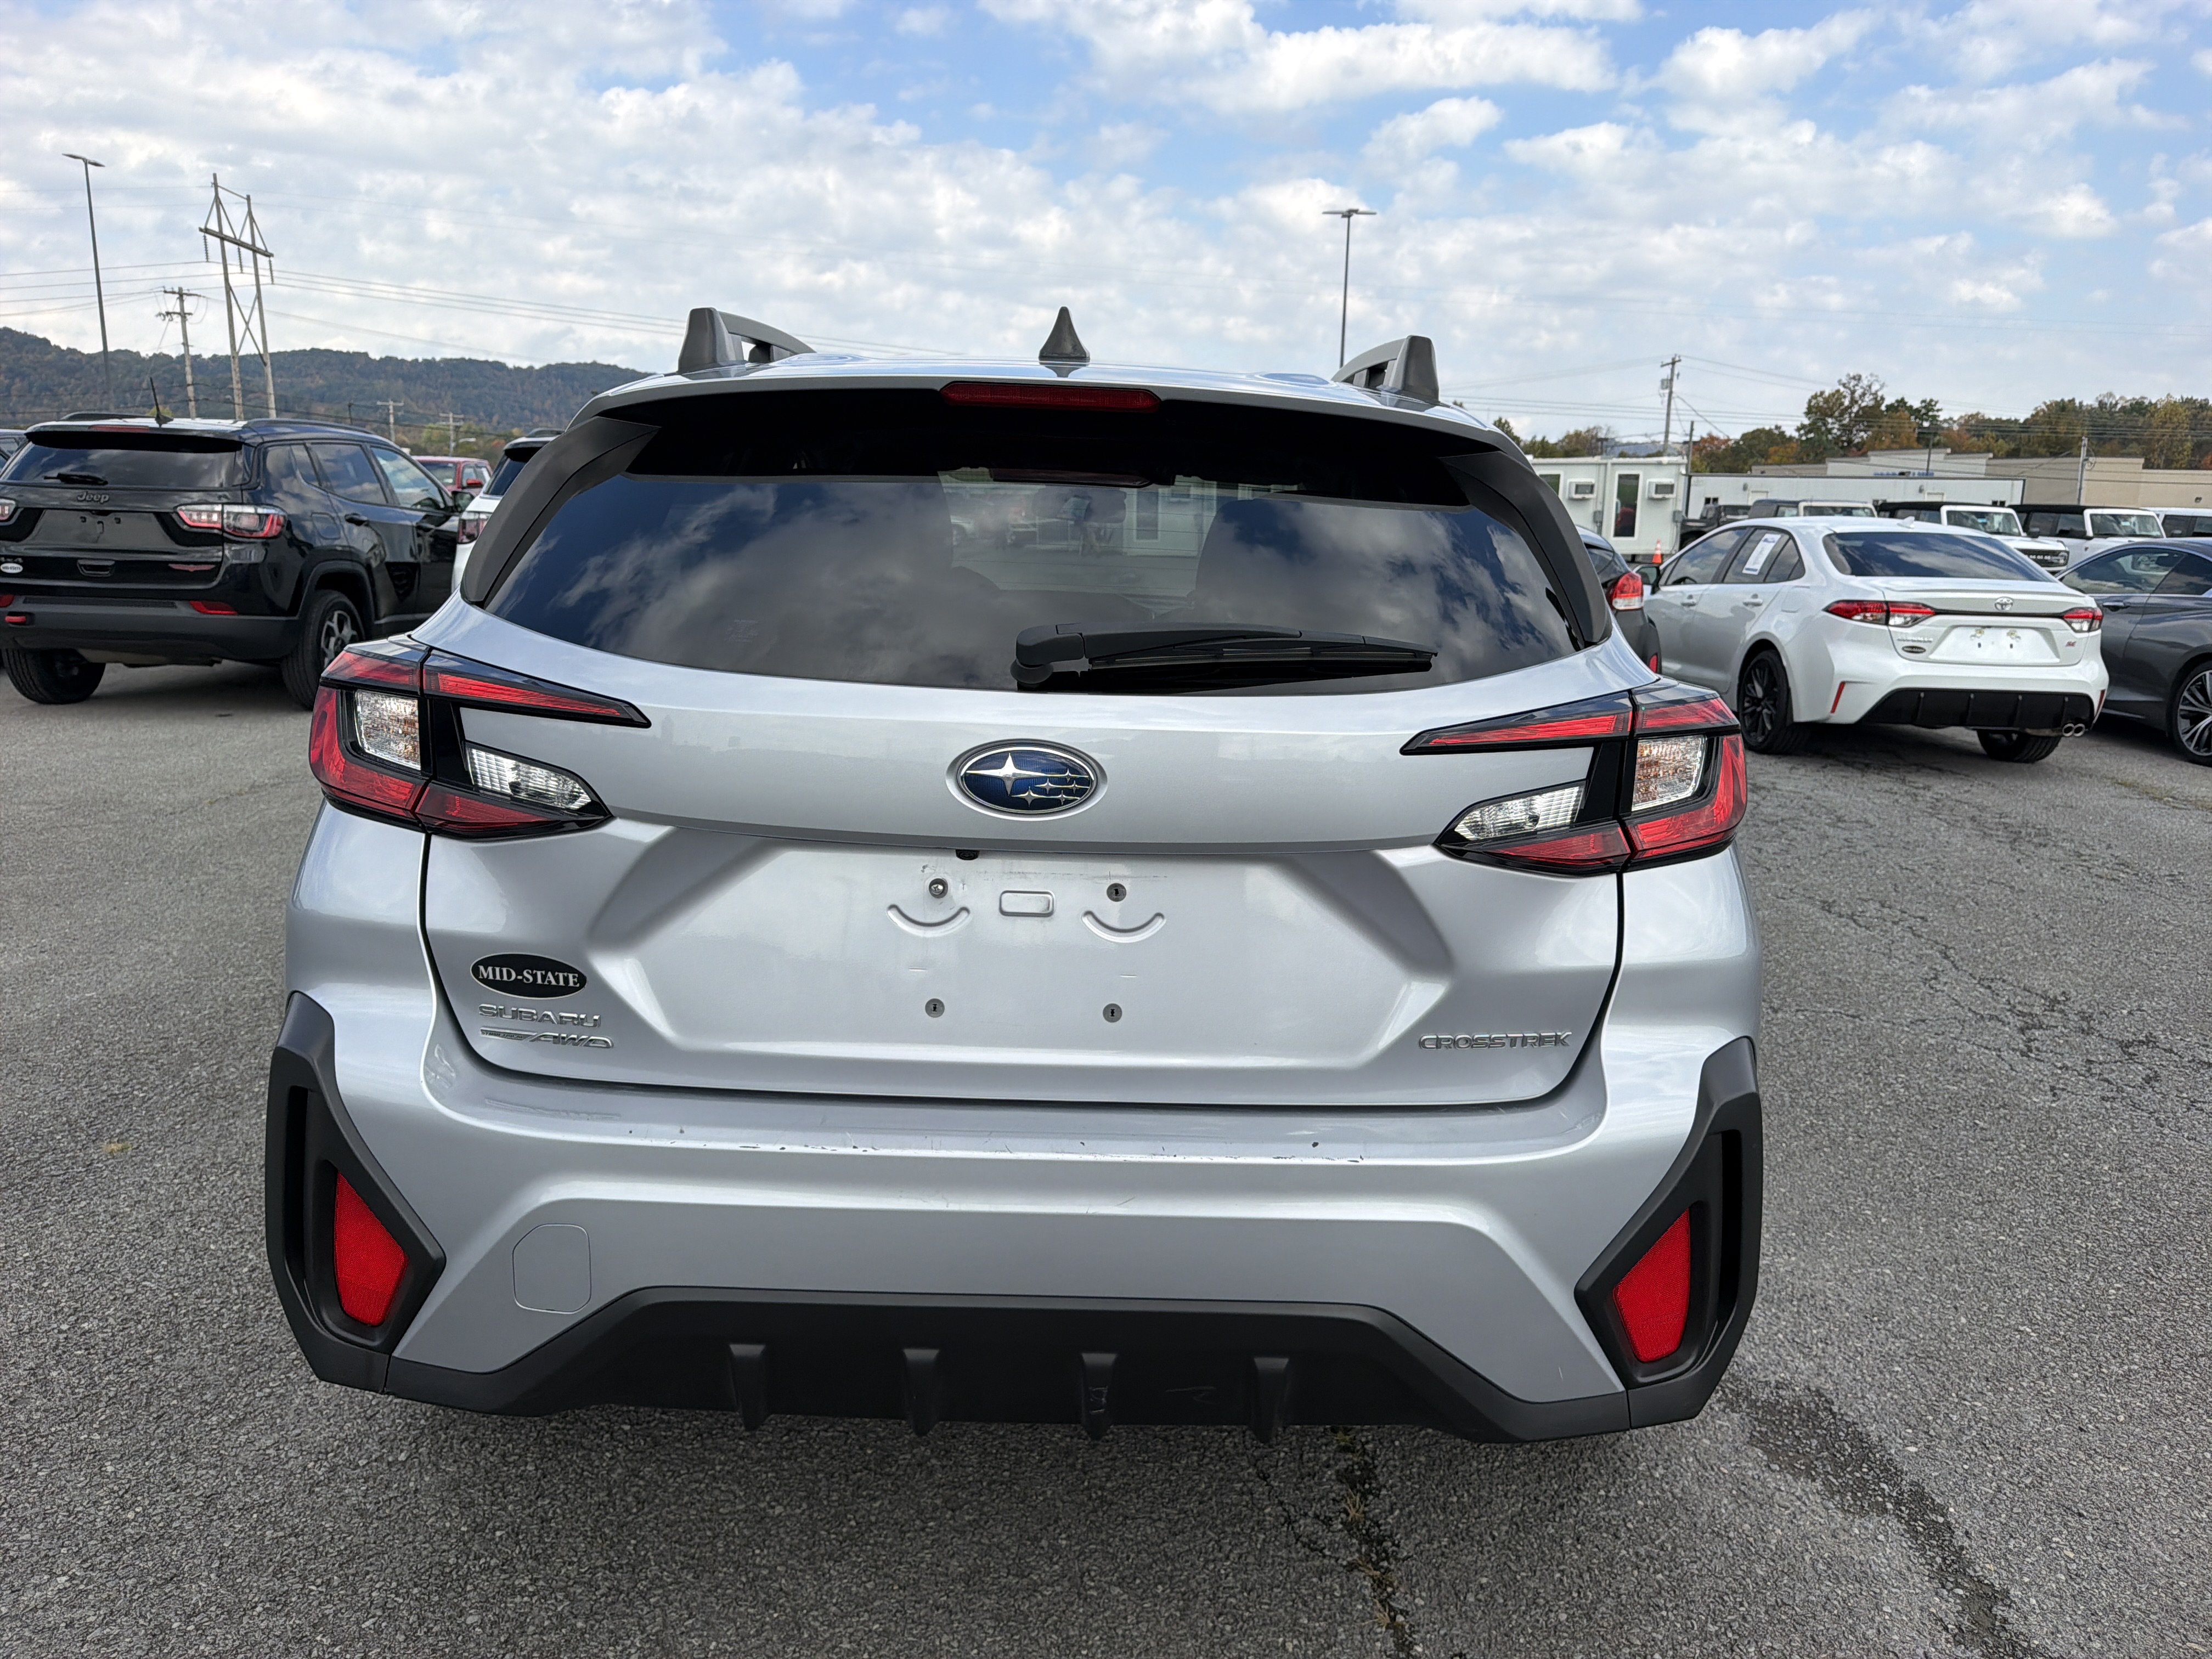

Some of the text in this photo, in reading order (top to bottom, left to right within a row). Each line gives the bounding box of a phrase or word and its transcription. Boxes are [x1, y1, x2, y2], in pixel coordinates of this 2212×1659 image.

[77, 491, 109, 504] Jeep
[478, 965, 580, 987] MID-STATE
[478, 1003, 602, 1028] SUBARU
[528, 1032, 614, 1048] AWD
[1419, 1031, 1572, 1050] CROSSTREK
